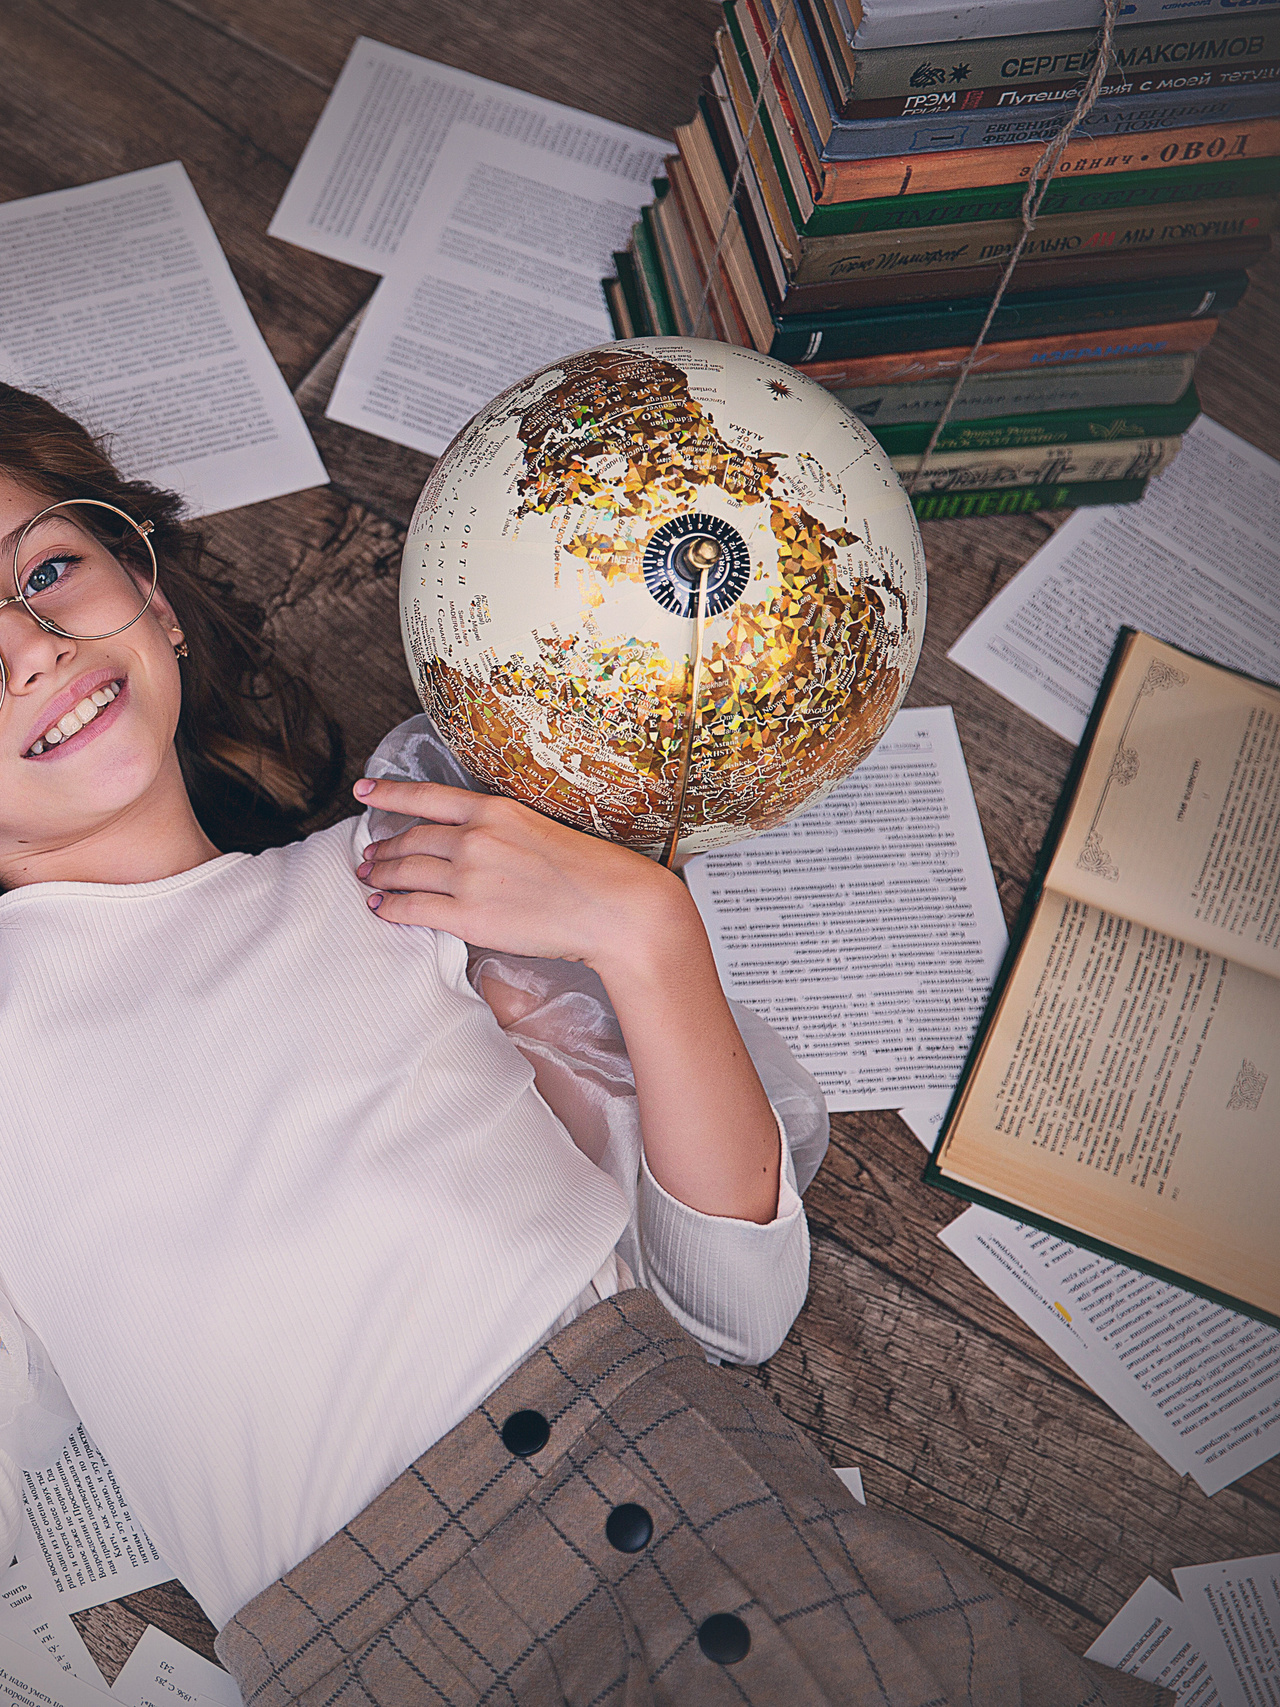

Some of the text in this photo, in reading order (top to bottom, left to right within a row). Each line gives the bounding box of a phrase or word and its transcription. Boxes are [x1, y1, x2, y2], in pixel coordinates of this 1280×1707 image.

[1117, 35, 1266, 68] МАКСИМОВ
[1156, 71, 1213, 91] моей
[904, 90, 958, 111] ГРЭМ
[985, 115, 1071, 135] ЕВГЕНИЙ
[1115, 116, 1176, 134] ПОЯС
[1159, 133, 1252, 164] ОВОД
[1084, 232, 1117, 250] ЛИ
[1120, 227, 1154, 245] МЫ
[729, 423, 764, 441] ALASKA
[729, 438, 752, 452] GULF
[523, 764, 548, 785] LIBYA
[596, 803, 628, 816] JORDAN
[83, 1474, 103, 1511] эстетика
[99, 1513, 111, 1530] как
[108, 1532, 122, 1558] Китч,
